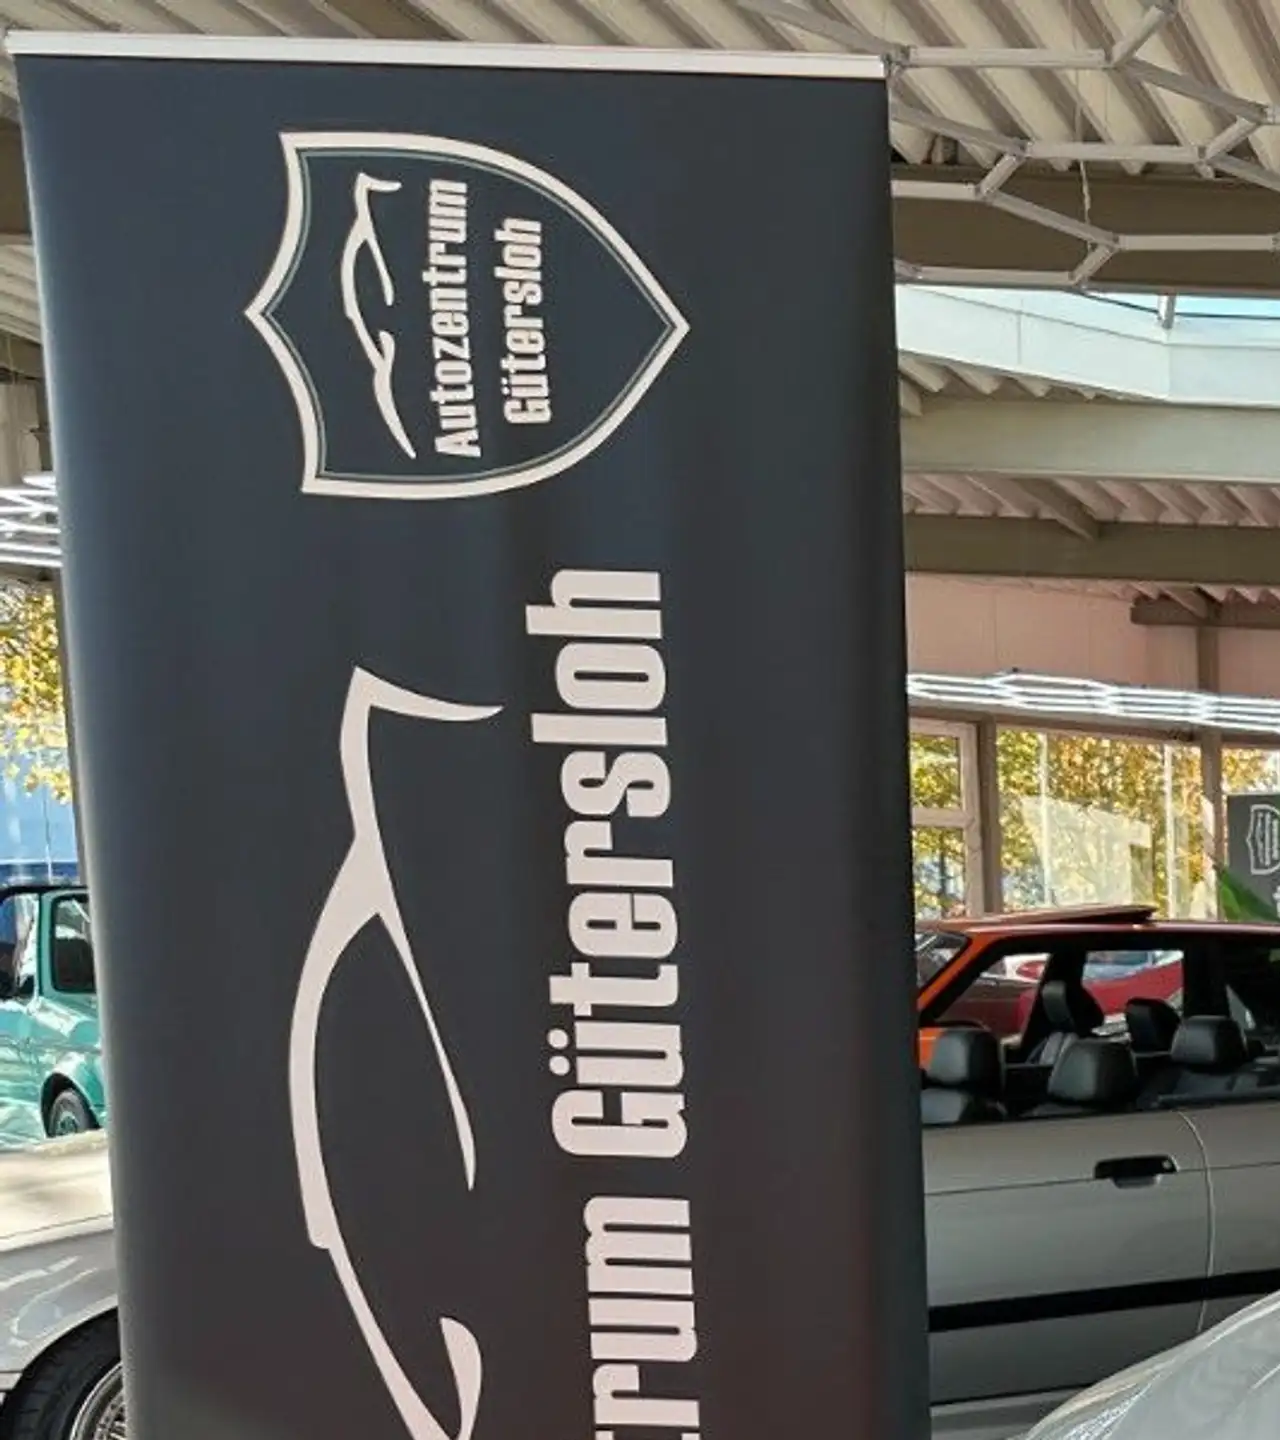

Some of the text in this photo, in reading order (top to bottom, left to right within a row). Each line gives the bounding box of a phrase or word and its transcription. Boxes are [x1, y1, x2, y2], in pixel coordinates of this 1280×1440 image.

[422, 179, 482, 458] Autozentrum
[494, 217, 552, 424] Gütersloh
[525, 570, 688, 1158] Gütersloh
